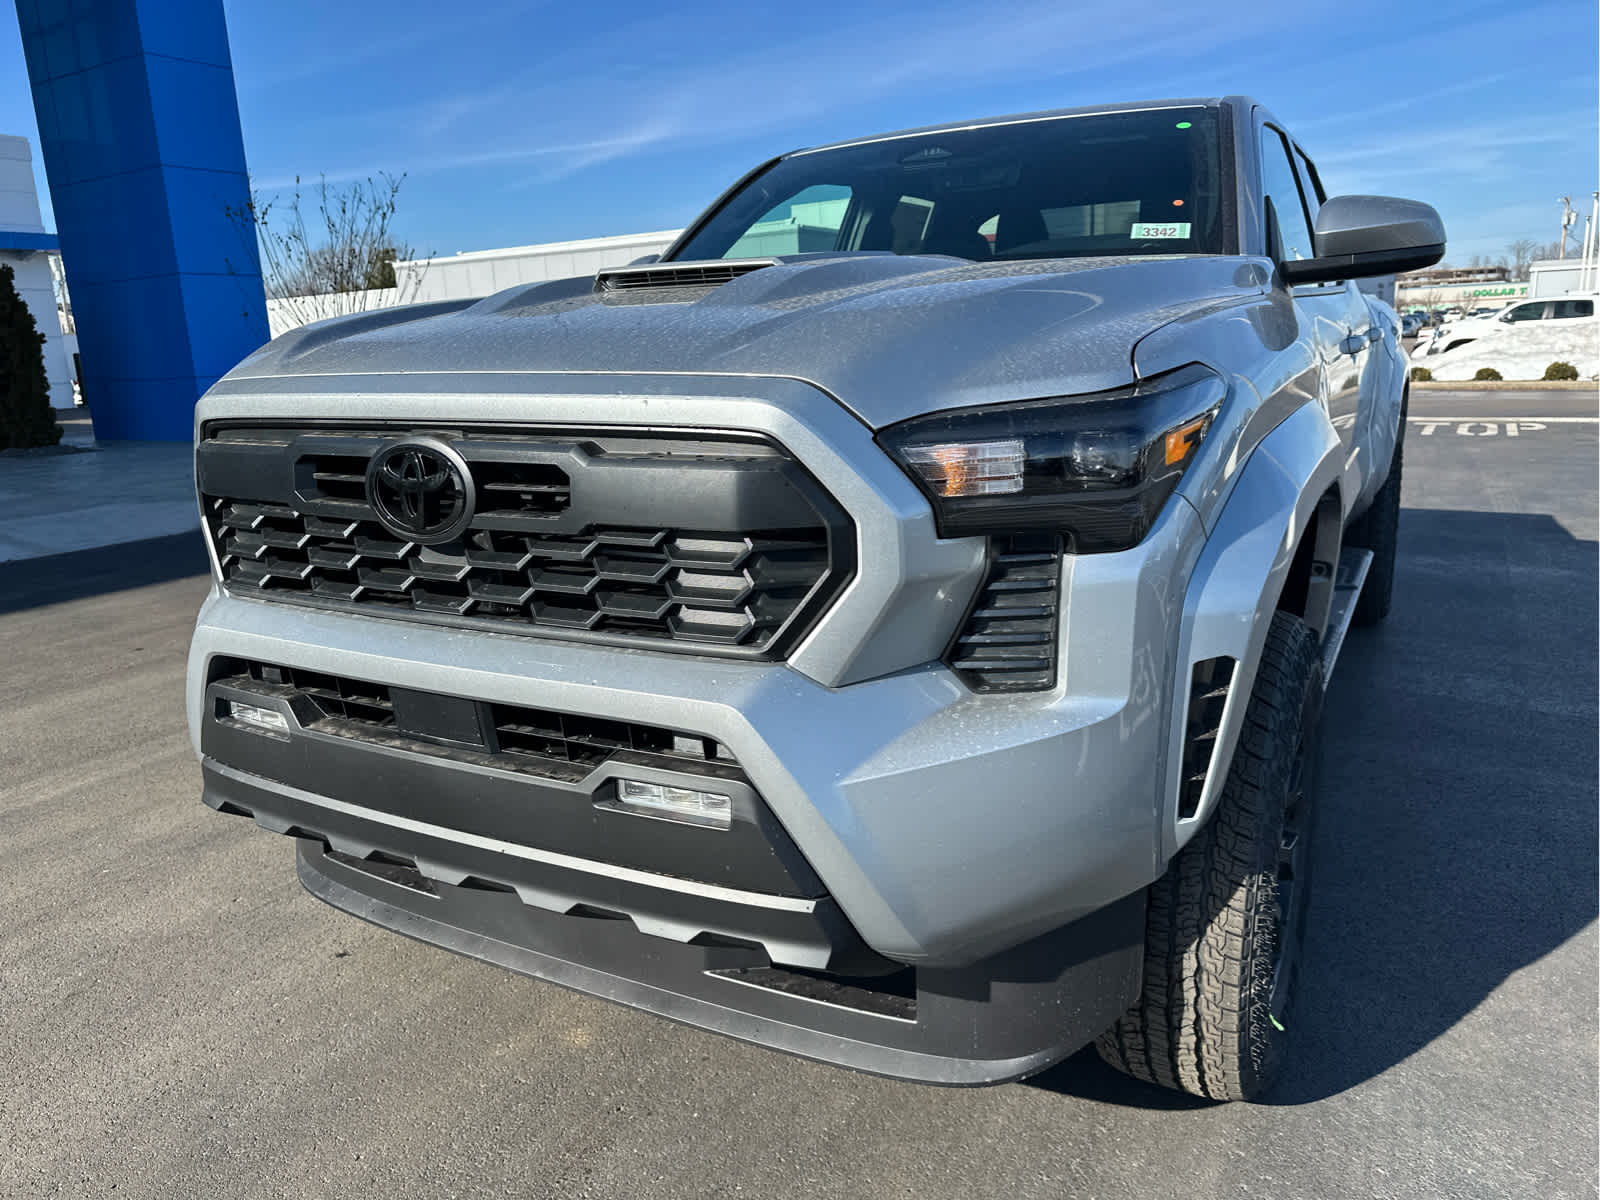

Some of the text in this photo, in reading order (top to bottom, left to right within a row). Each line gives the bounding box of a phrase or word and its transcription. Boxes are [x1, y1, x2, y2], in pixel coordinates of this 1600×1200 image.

[1143, 227, 1177, 237] 3342
[1473, 288, 1515, 297] DOLLAR
[1413, 422, 1547, 437] TOP
